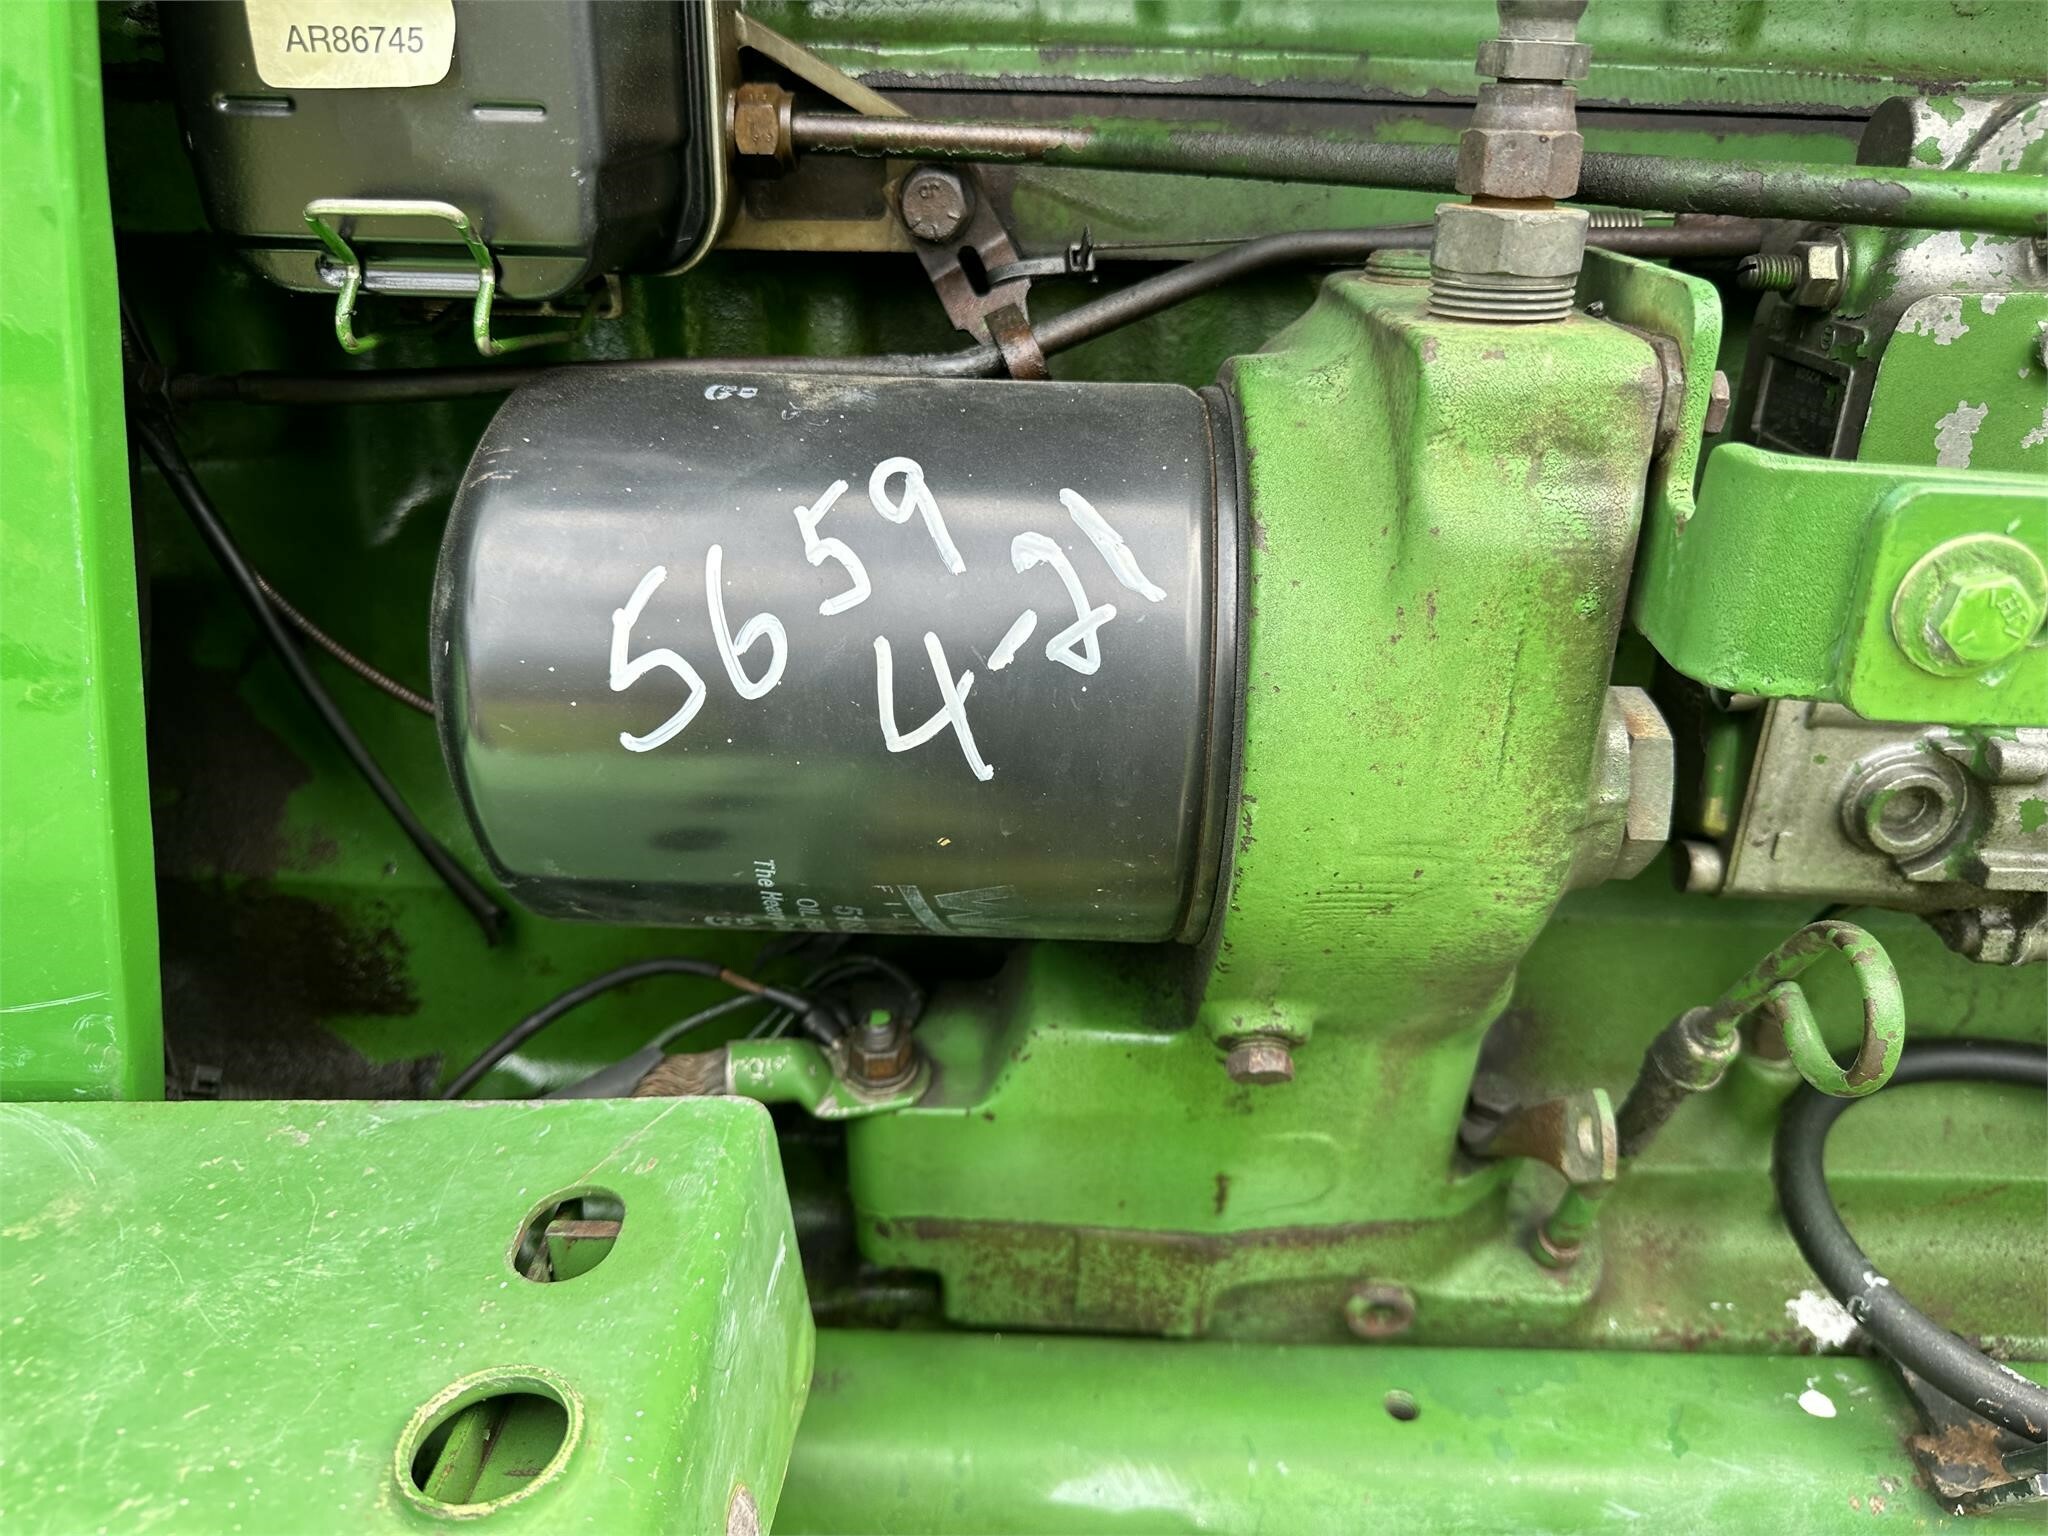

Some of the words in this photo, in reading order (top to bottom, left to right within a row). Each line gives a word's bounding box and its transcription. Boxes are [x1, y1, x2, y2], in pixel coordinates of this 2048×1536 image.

[286, 25, 423, 53] AR86745
[754, 860, 776, 887] The
[796, 898, 822, 917] OIL
